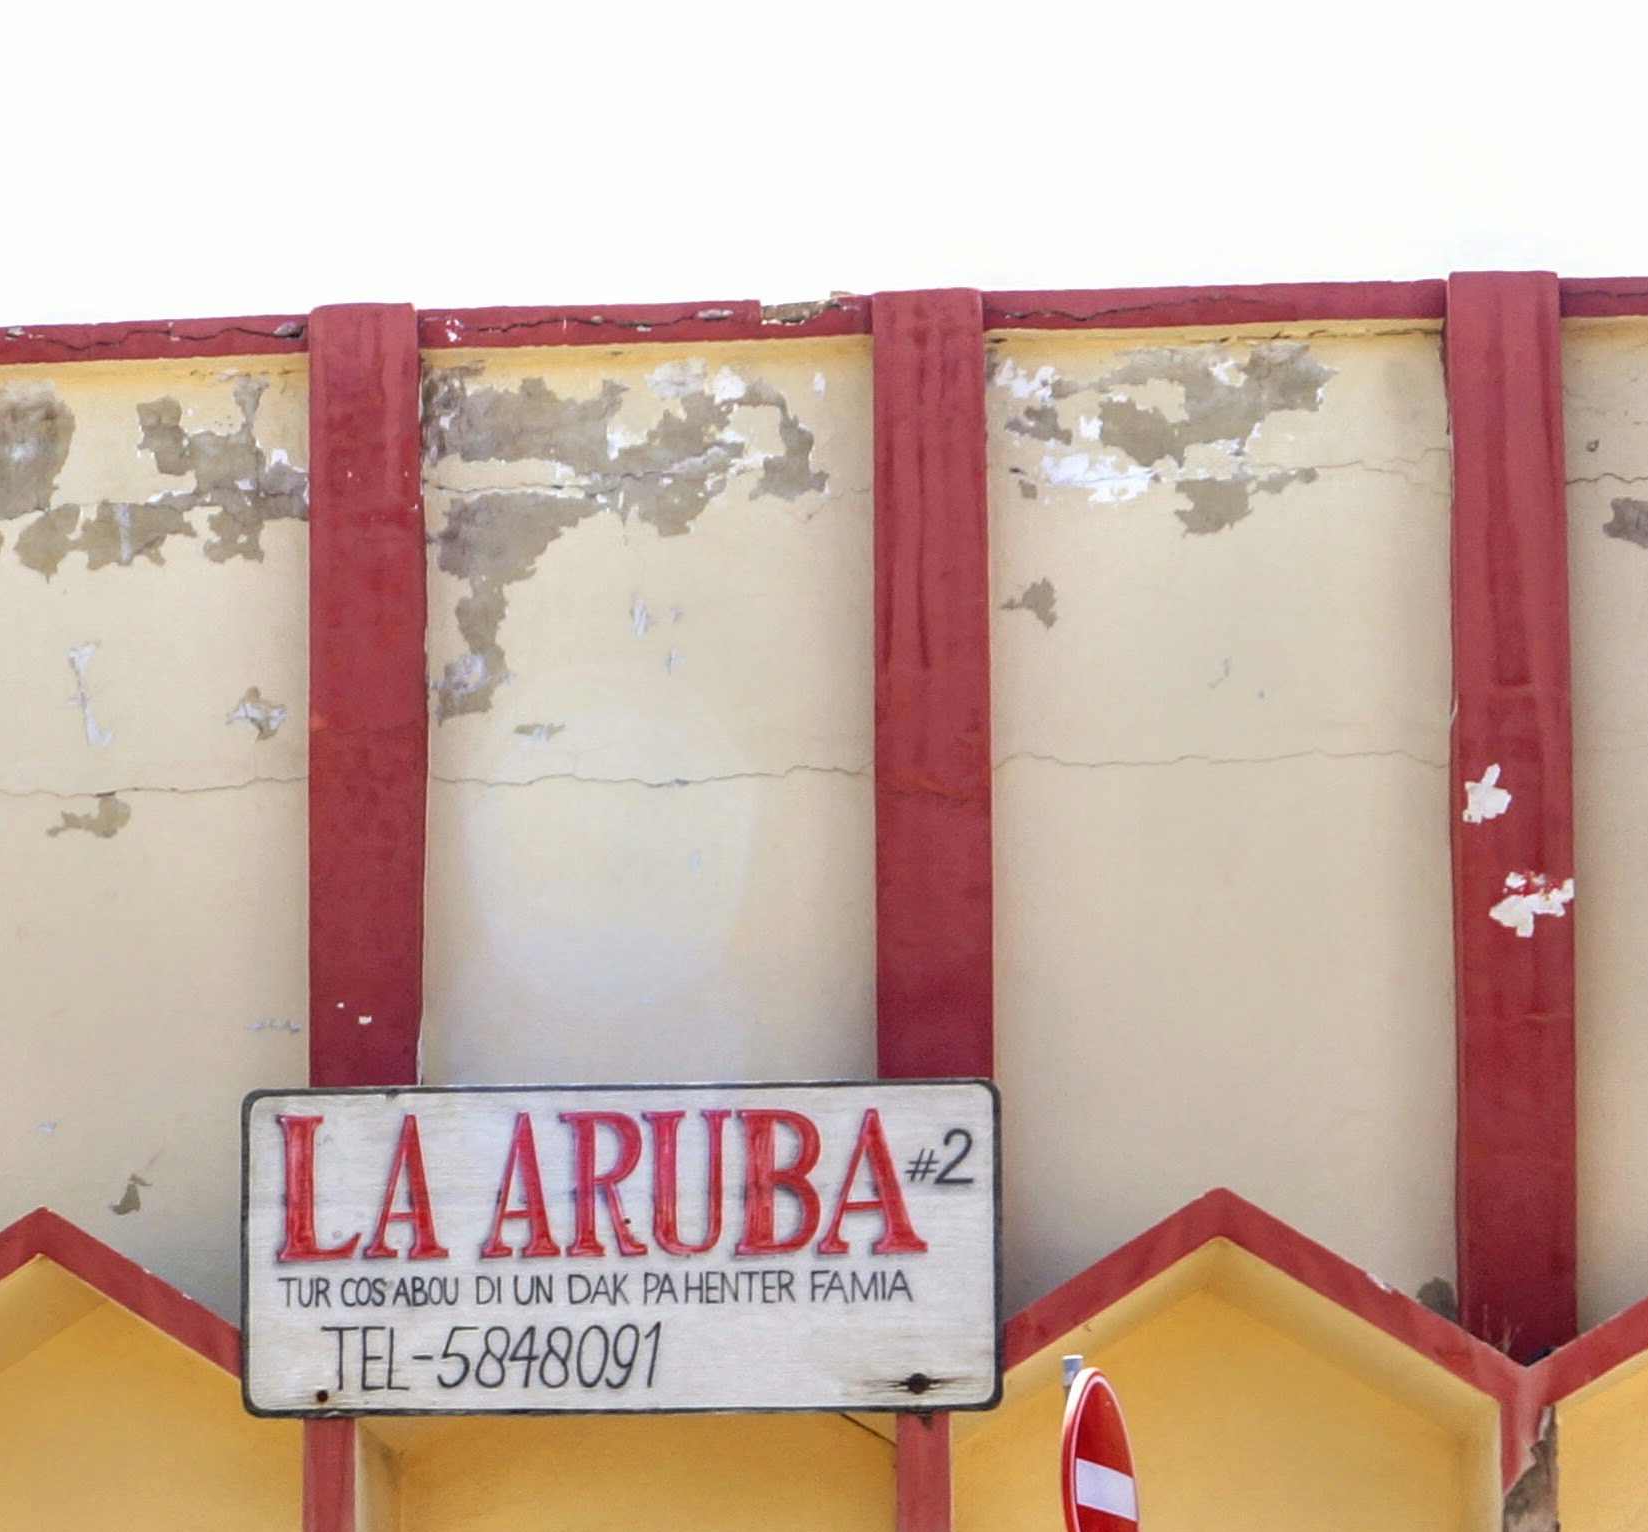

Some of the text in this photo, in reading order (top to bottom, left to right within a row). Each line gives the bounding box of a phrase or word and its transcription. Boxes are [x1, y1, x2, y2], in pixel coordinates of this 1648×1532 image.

[276, 1108, 928, 1264] LA ARUBA
[905, 1127, 975, 1186] #2
[277, 1277, 332, 1307] TUR
[476, 1275, 502, 1305] DI
[513, 1274, 553, 1305] UN
[568, 1272, 629, 1306] DAK
[643, 1271, 679, 1306] PA
[684, 1270, 796, 1304] HENTER
[809, 1269, 914, 1303] FAMIA
